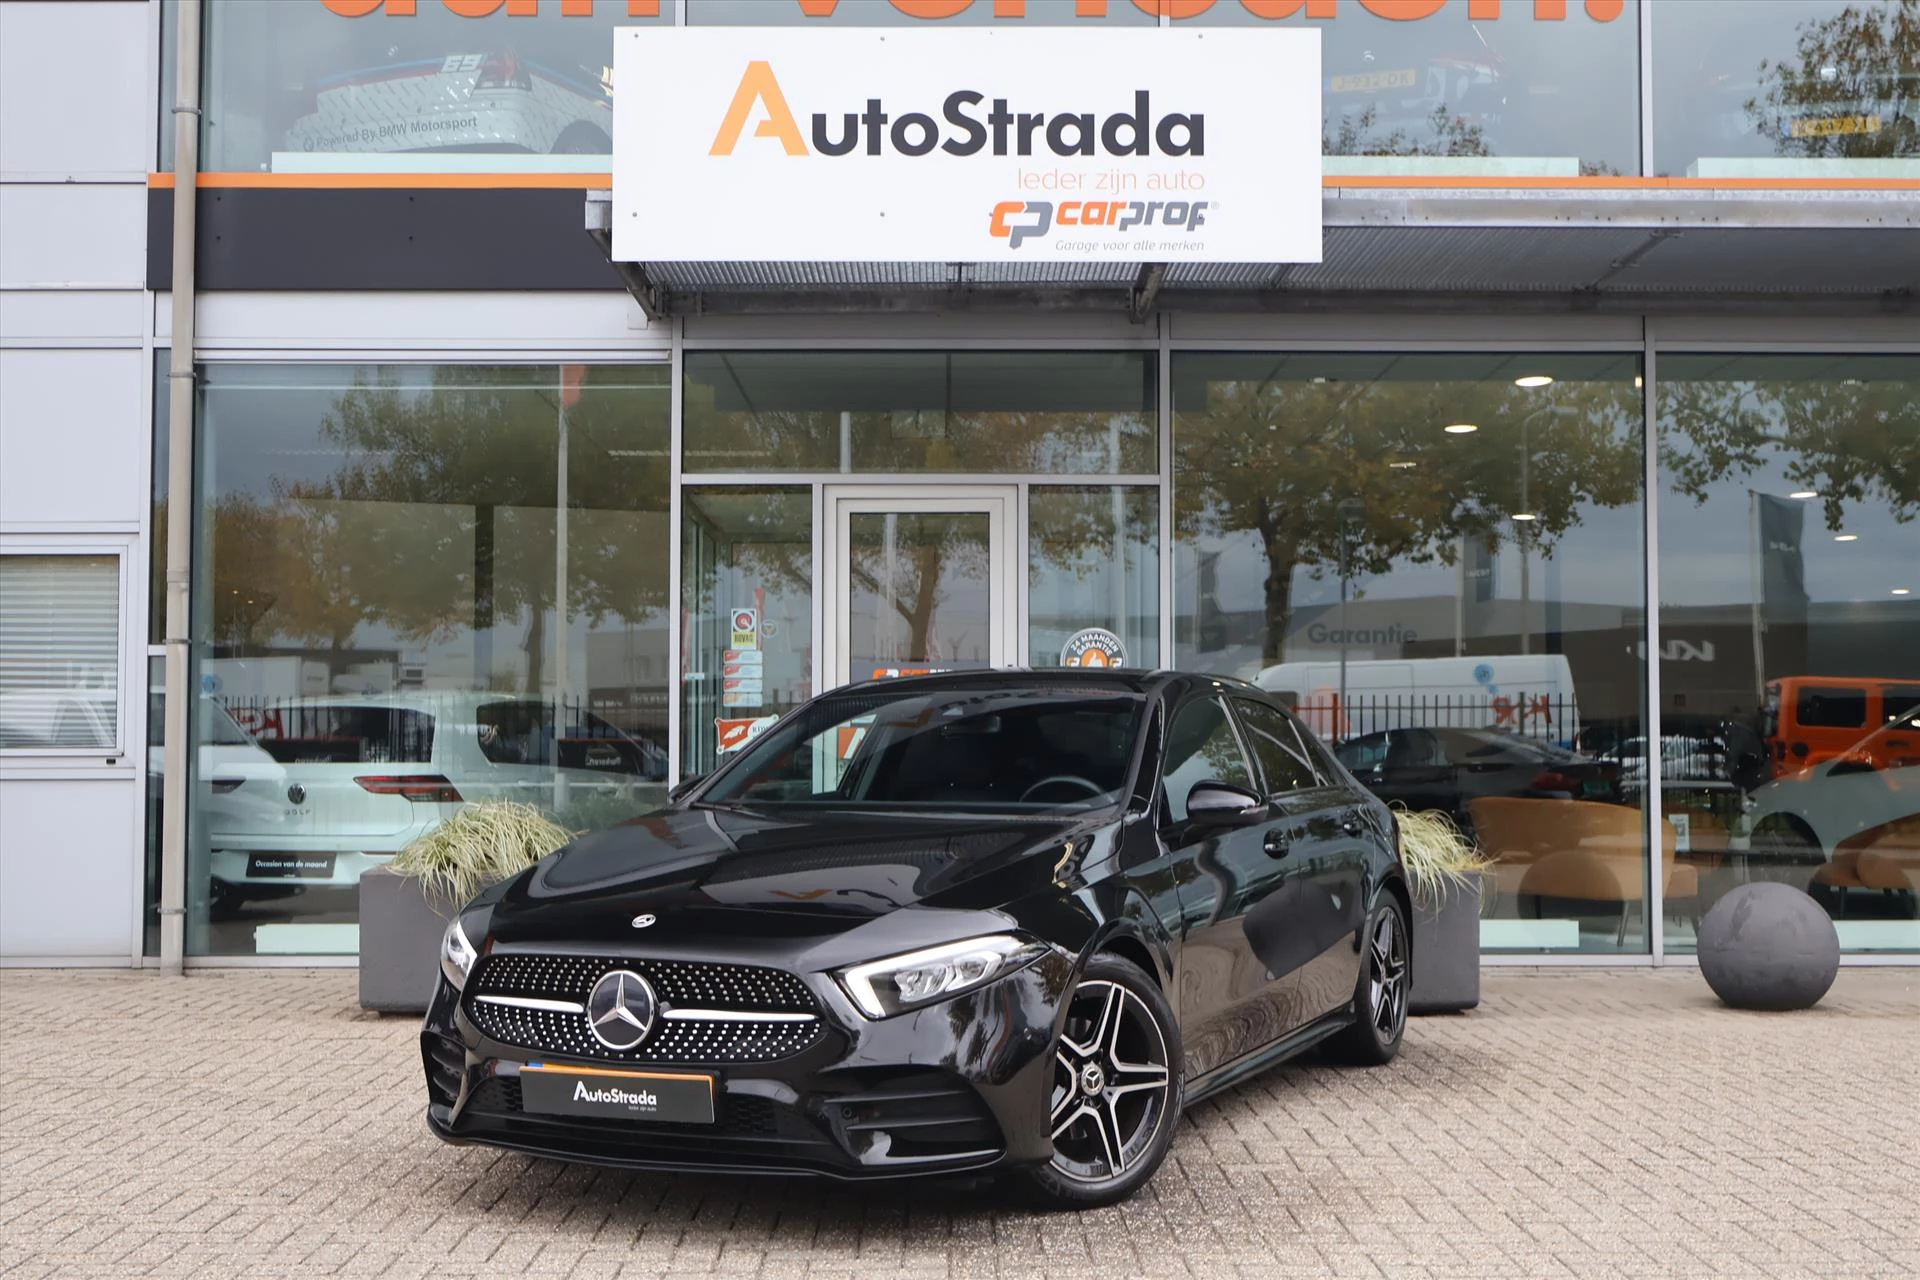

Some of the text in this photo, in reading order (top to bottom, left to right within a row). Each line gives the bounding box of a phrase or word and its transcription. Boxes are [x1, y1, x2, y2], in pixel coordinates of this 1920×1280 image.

[441, 53, 483, 73] 69
[708, 60, 1204, 157] AutoStrada
[316, 116, 478, 147] Powered By BMW Motorsport
[1017, 168, 1205, 195] Ieder zijn auto
[1055, 239, 1205, 252] Garage voor alle merken
[1080, 633, 1119, 653] MAANDEN
[1307, 622, 1418, 645] Garantie
[1076, 641, 1114, 656] GARANTIE
[255, 860, 282, 868] Occasion
[295, 860, 304, 868] de
[304, 860, 328, 869] maand
[573, 1080, 657, 1106] AutoStrada
